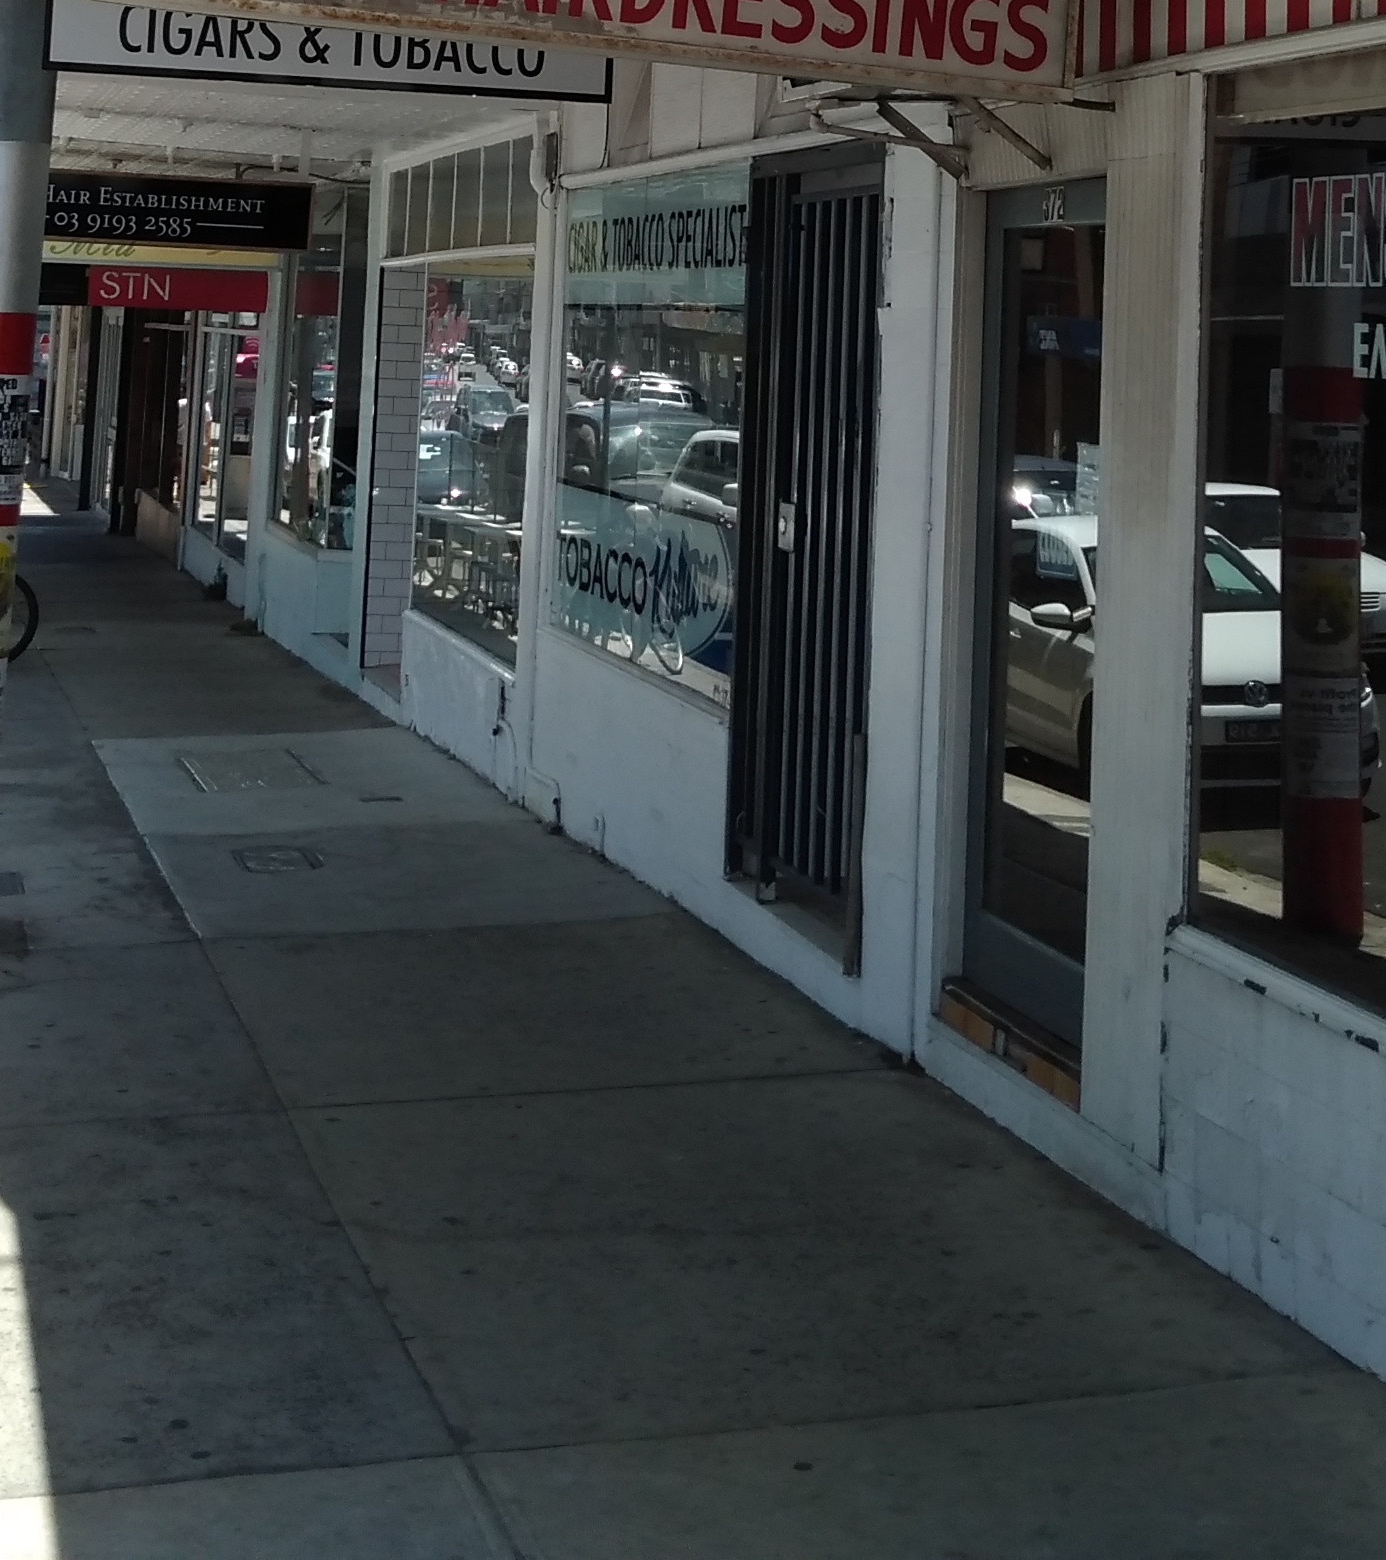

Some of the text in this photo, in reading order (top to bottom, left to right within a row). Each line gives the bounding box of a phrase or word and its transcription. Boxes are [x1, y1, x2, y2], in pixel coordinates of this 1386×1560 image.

[118, 5, 283, 62] CIGARS
[298, 26, 330, 66] &
[54, 211, 192, 238] 03 9193 2585
[568, 220, 598, 274] CIGAR
[600, 219, 609, 273] &
[612, 212, 664, 272] TOBACCO
[99, 271, 171, 302] STN
[556, 528, 648, 616] TOBACCO
